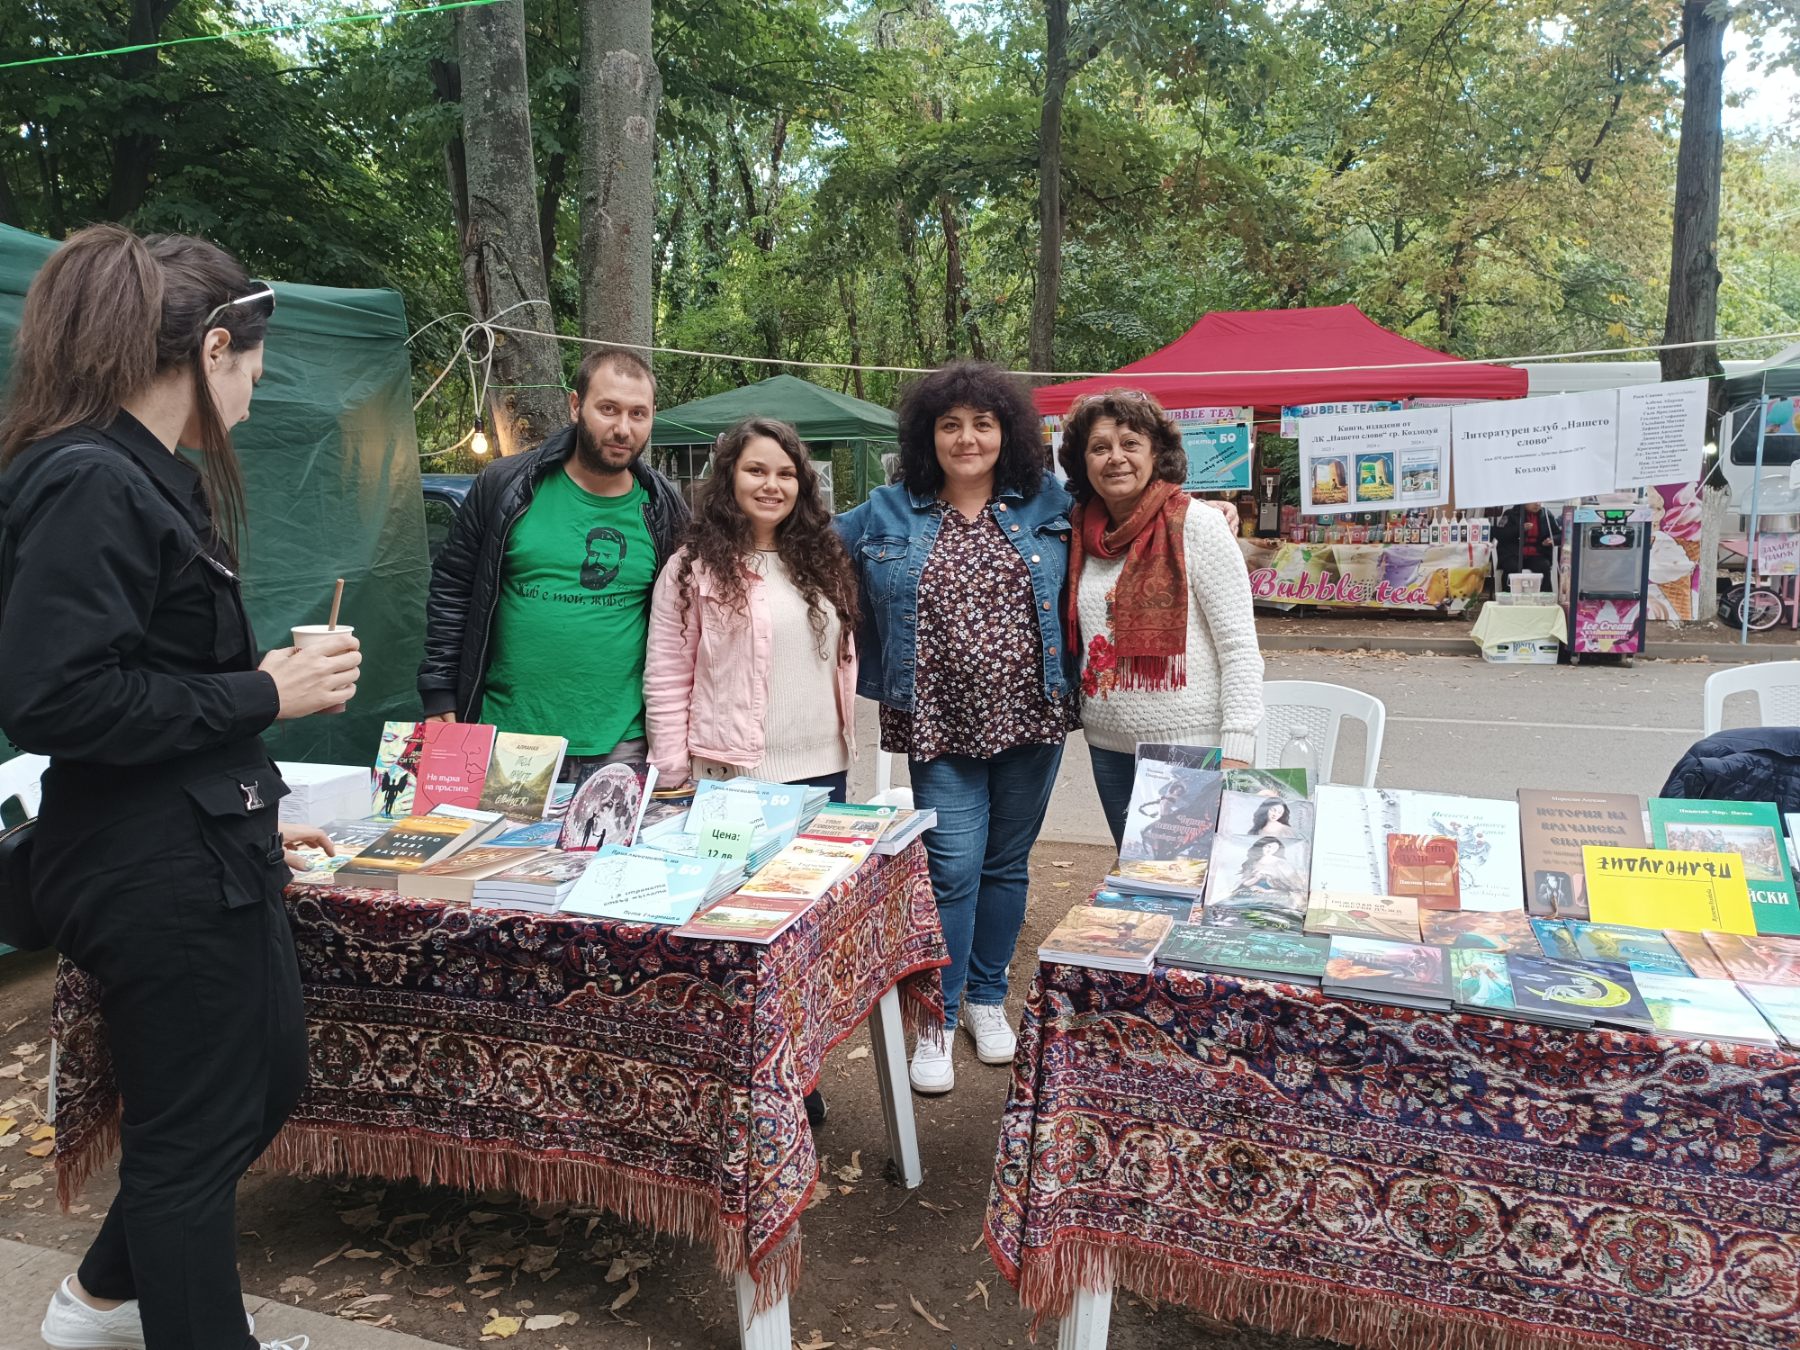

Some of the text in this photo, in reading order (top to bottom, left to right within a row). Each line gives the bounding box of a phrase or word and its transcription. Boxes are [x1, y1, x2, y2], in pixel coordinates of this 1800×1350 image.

[1210, 408, 1234, 418] TEA
[1300, 404, 1377, 416] BUBBLE TEA
[1461, 427, 1529, 441] Литературен
[1533, 421, 1559, 435] клуб
[1515, 464, 1557, 475] Козлодуй
[1248, 567, 1429, 605] Bubble tea
[541, 591, 550, 601] е
[1582, 620, 1634, 632] Ice Cream
[426, 772, 437, 782] На
[425, 783, 470, 795] на пръстите
[1536, 806, 1629, 821] ИСТОРИЯ НА
[1540, 822, 1627, 835] ВРАЧАНСКА
[393, 833, 442, 843] КЪДЕТО
[712, 828, 741, 842] Цена:
[392, 841, 424, 849] ПЕЯТ
[1597, 855, 1732, 879] ПЪЛНОЛУДИЕ
